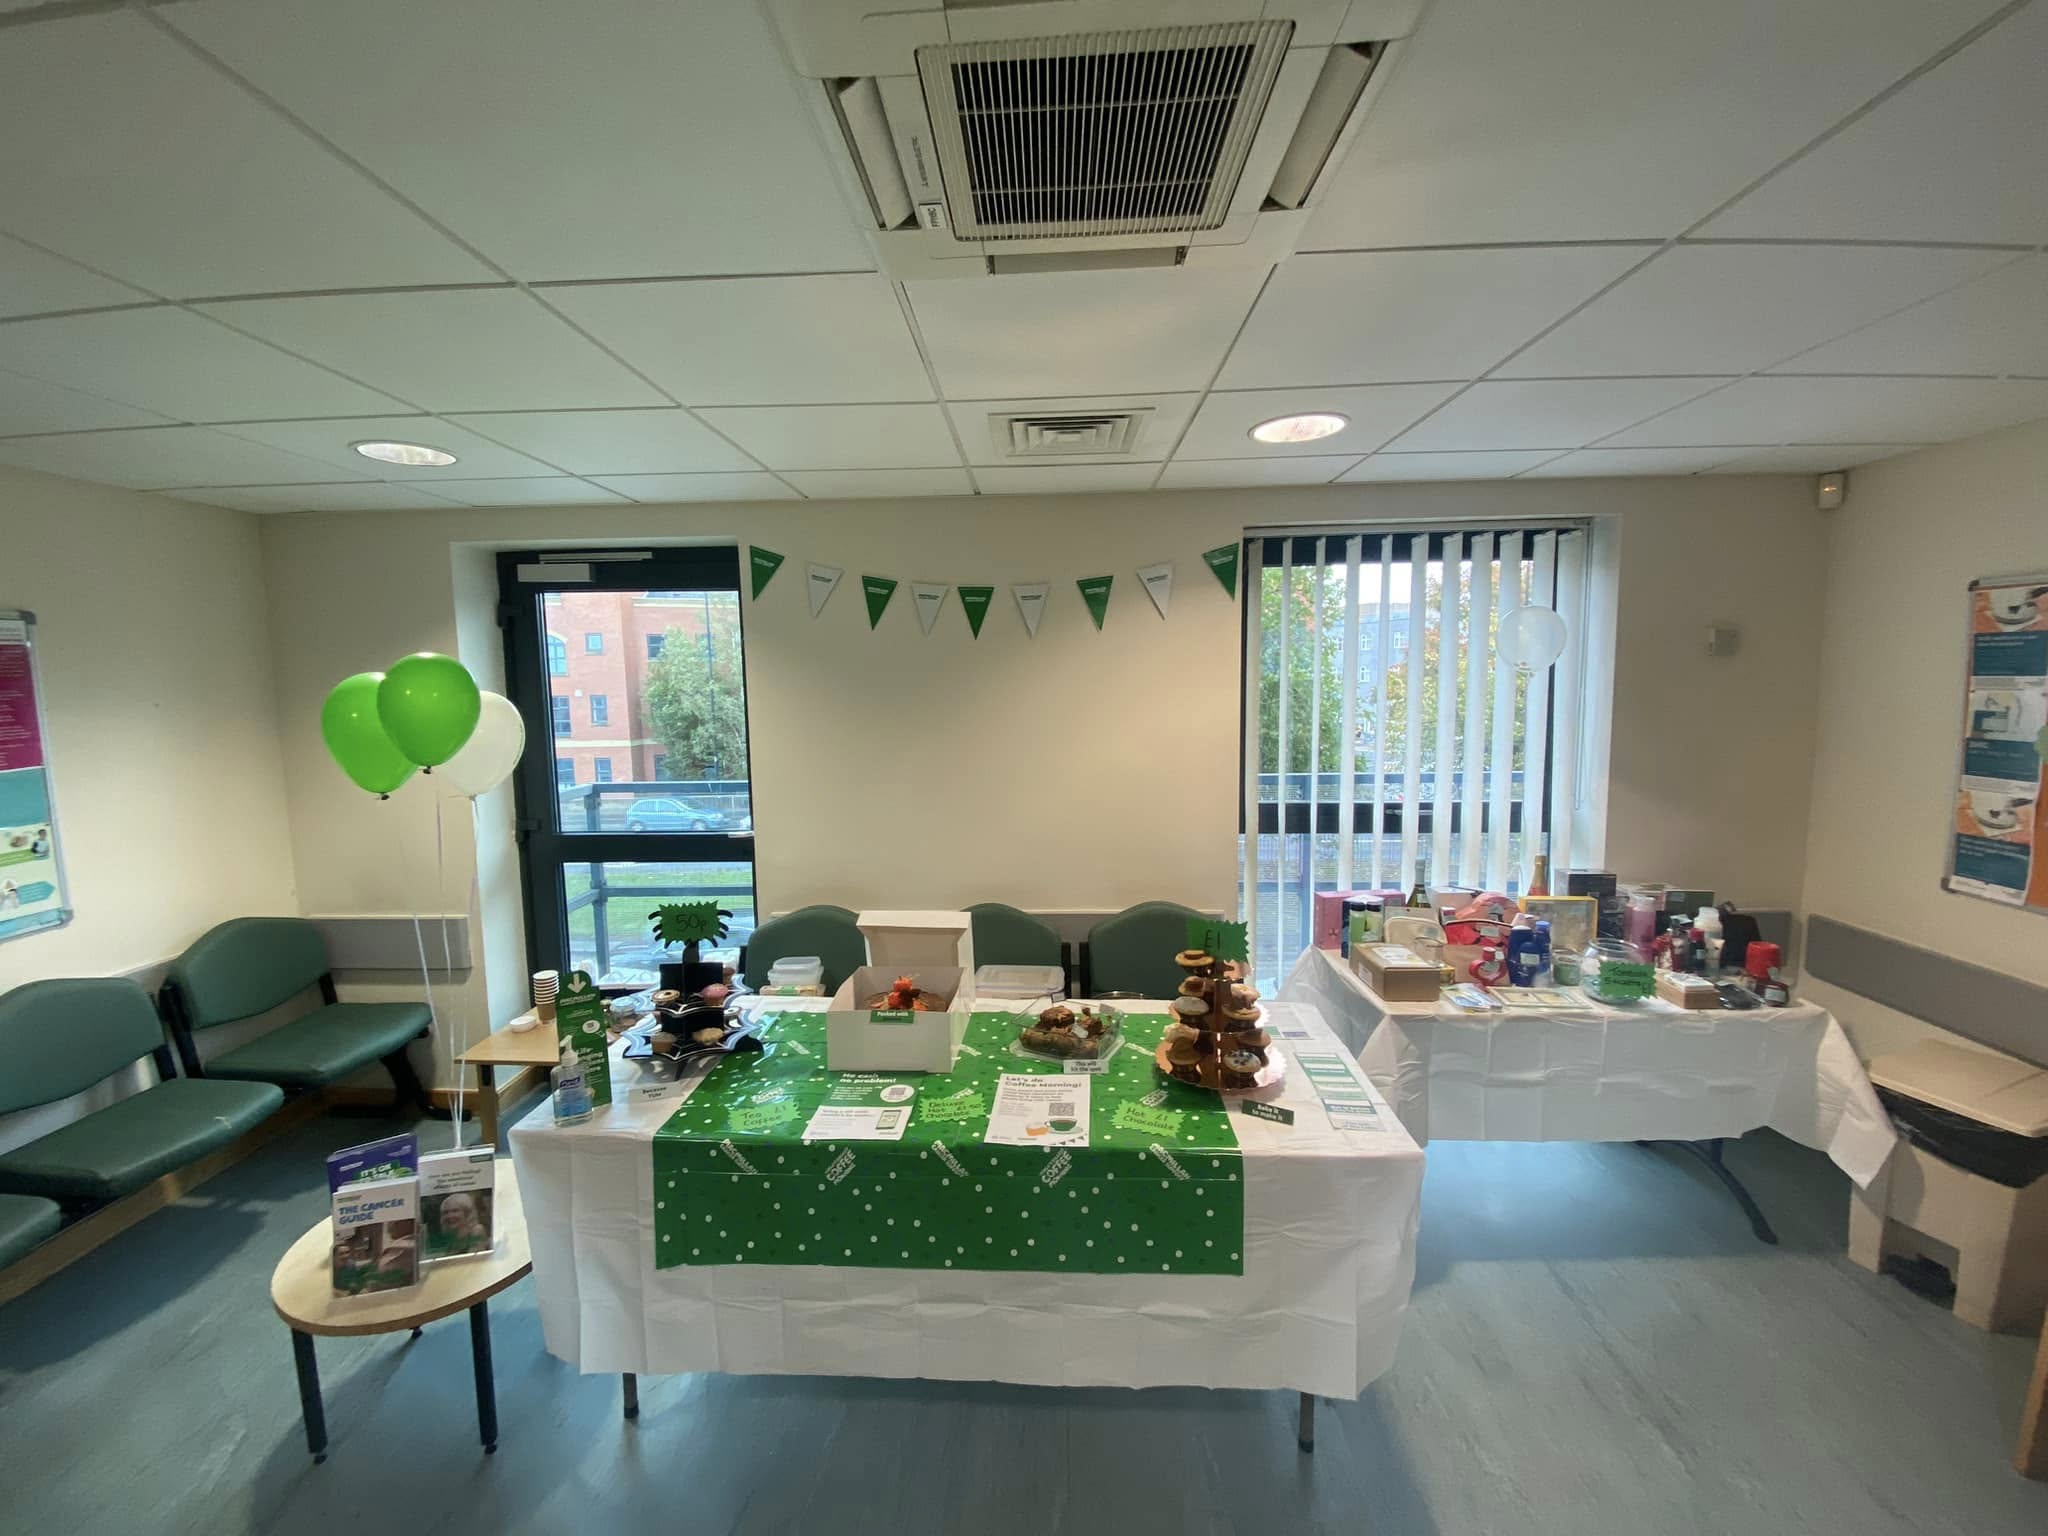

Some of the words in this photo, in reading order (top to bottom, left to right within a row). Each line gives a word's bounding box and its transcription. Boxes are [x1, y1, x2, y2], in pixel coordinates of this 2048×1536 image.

[676, 913, 707, 932] 50p
[743, 1111, 762, 1120] Tea
[1126, 1107, 1145, 1117] Hot
[824, 1149, 856, 1182] COFFEE
[1040, 1151, 1073, 1184] COFFEE
[1149, 1142, 1191, 1180] MACMILLAN
[339, 1205, 359, 1215] THE
[361, 1198, 405, 1211] CANCER
[339, 1211, 374, 1224] GUIDE
